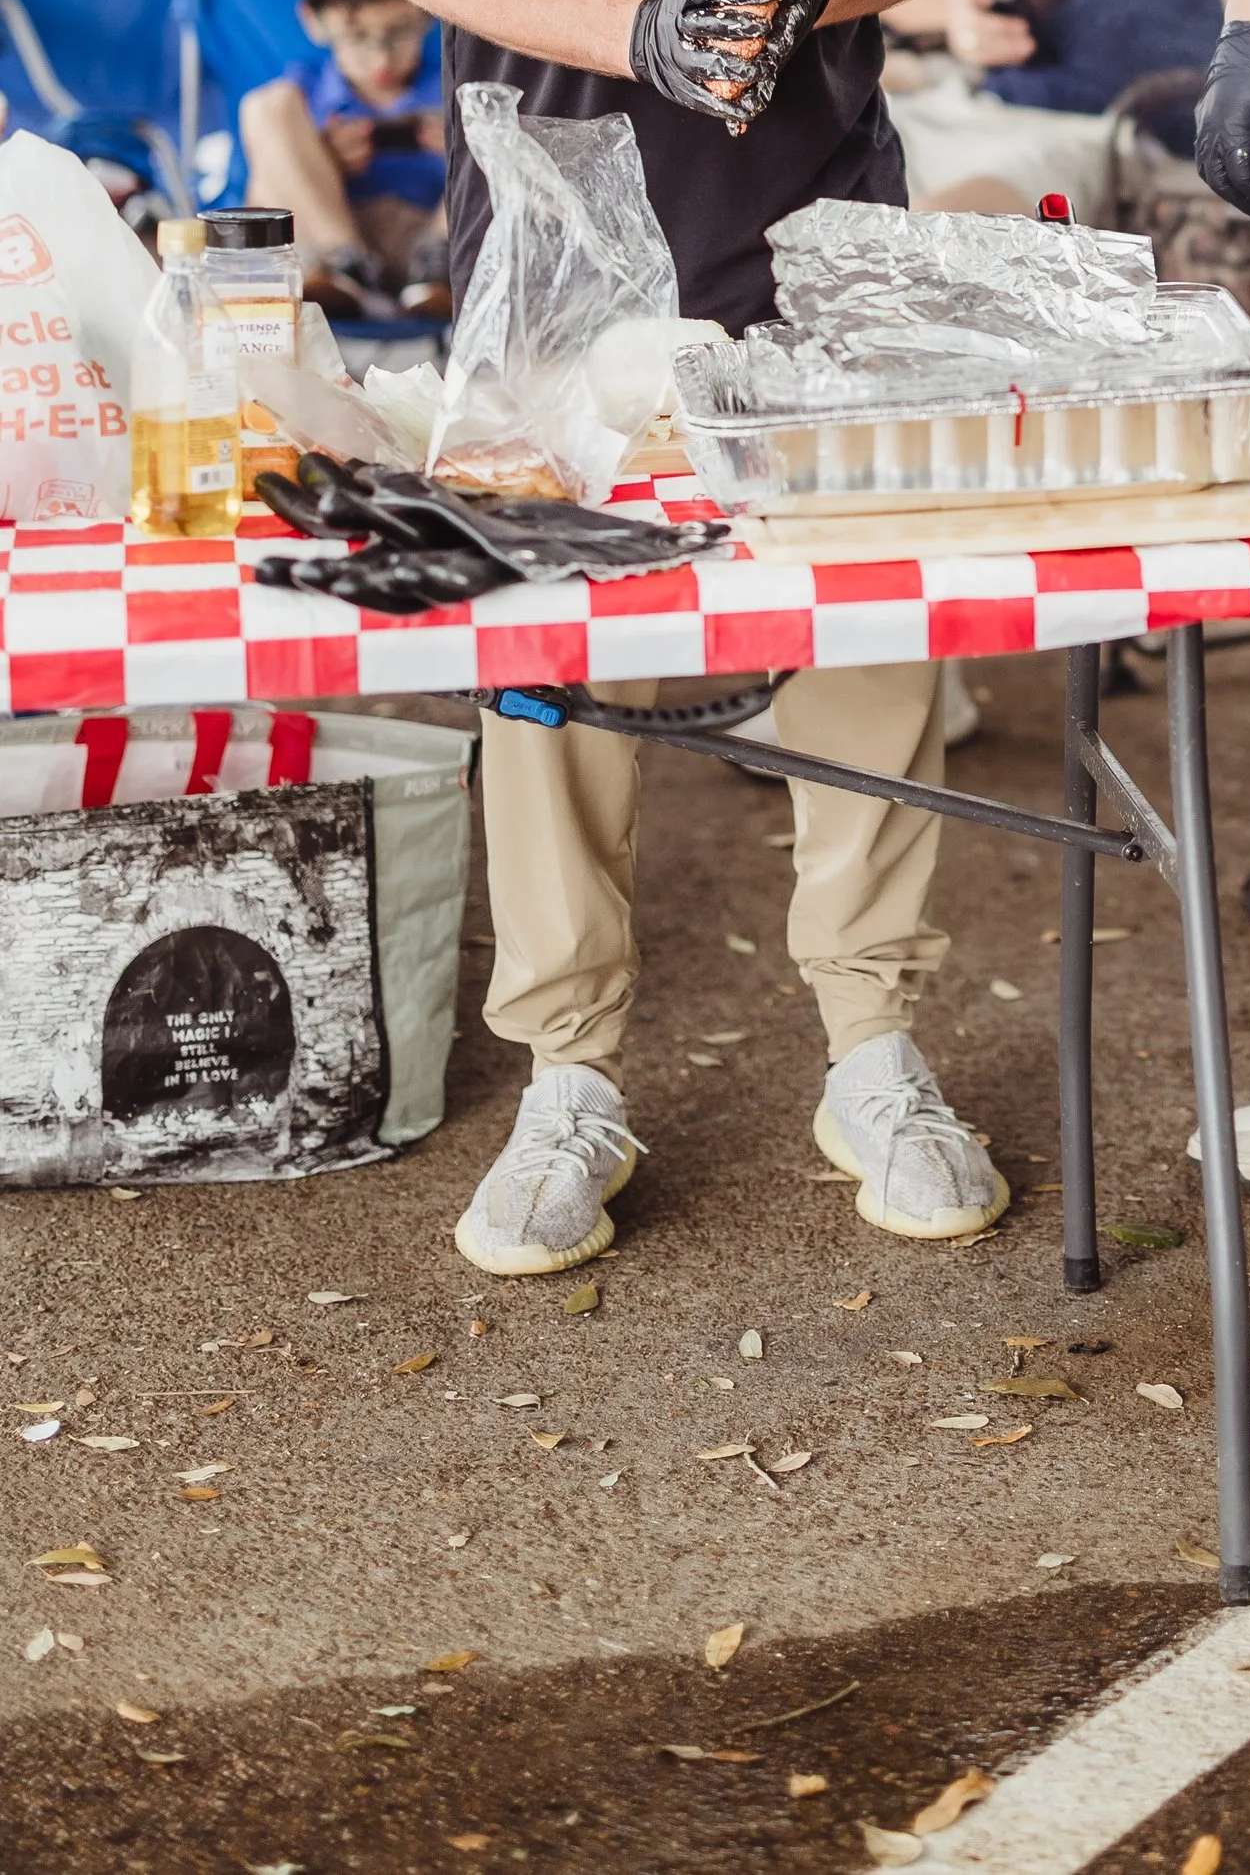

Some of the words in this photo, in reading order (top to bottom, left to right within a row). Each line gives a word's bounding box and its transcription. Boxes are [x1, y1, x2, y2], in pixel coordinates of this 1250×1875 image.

[240, 323, 281, 332] TIENDA
[74, 359, 112, 390] at
[0, 401, 128, 442] H-E-B
[166, 1012, 192, 1027] THE
[198, 1009, 235, 1025] ONLY
[172, 1026, 220, 1043] MAGIC
[181, 1042, 218, 1057] STILL
[174, 1055, 230, 1072] BELIEVE
[164, 1073, 180, 1088] IN
[202, 1067, 239, 1083] LOVE
